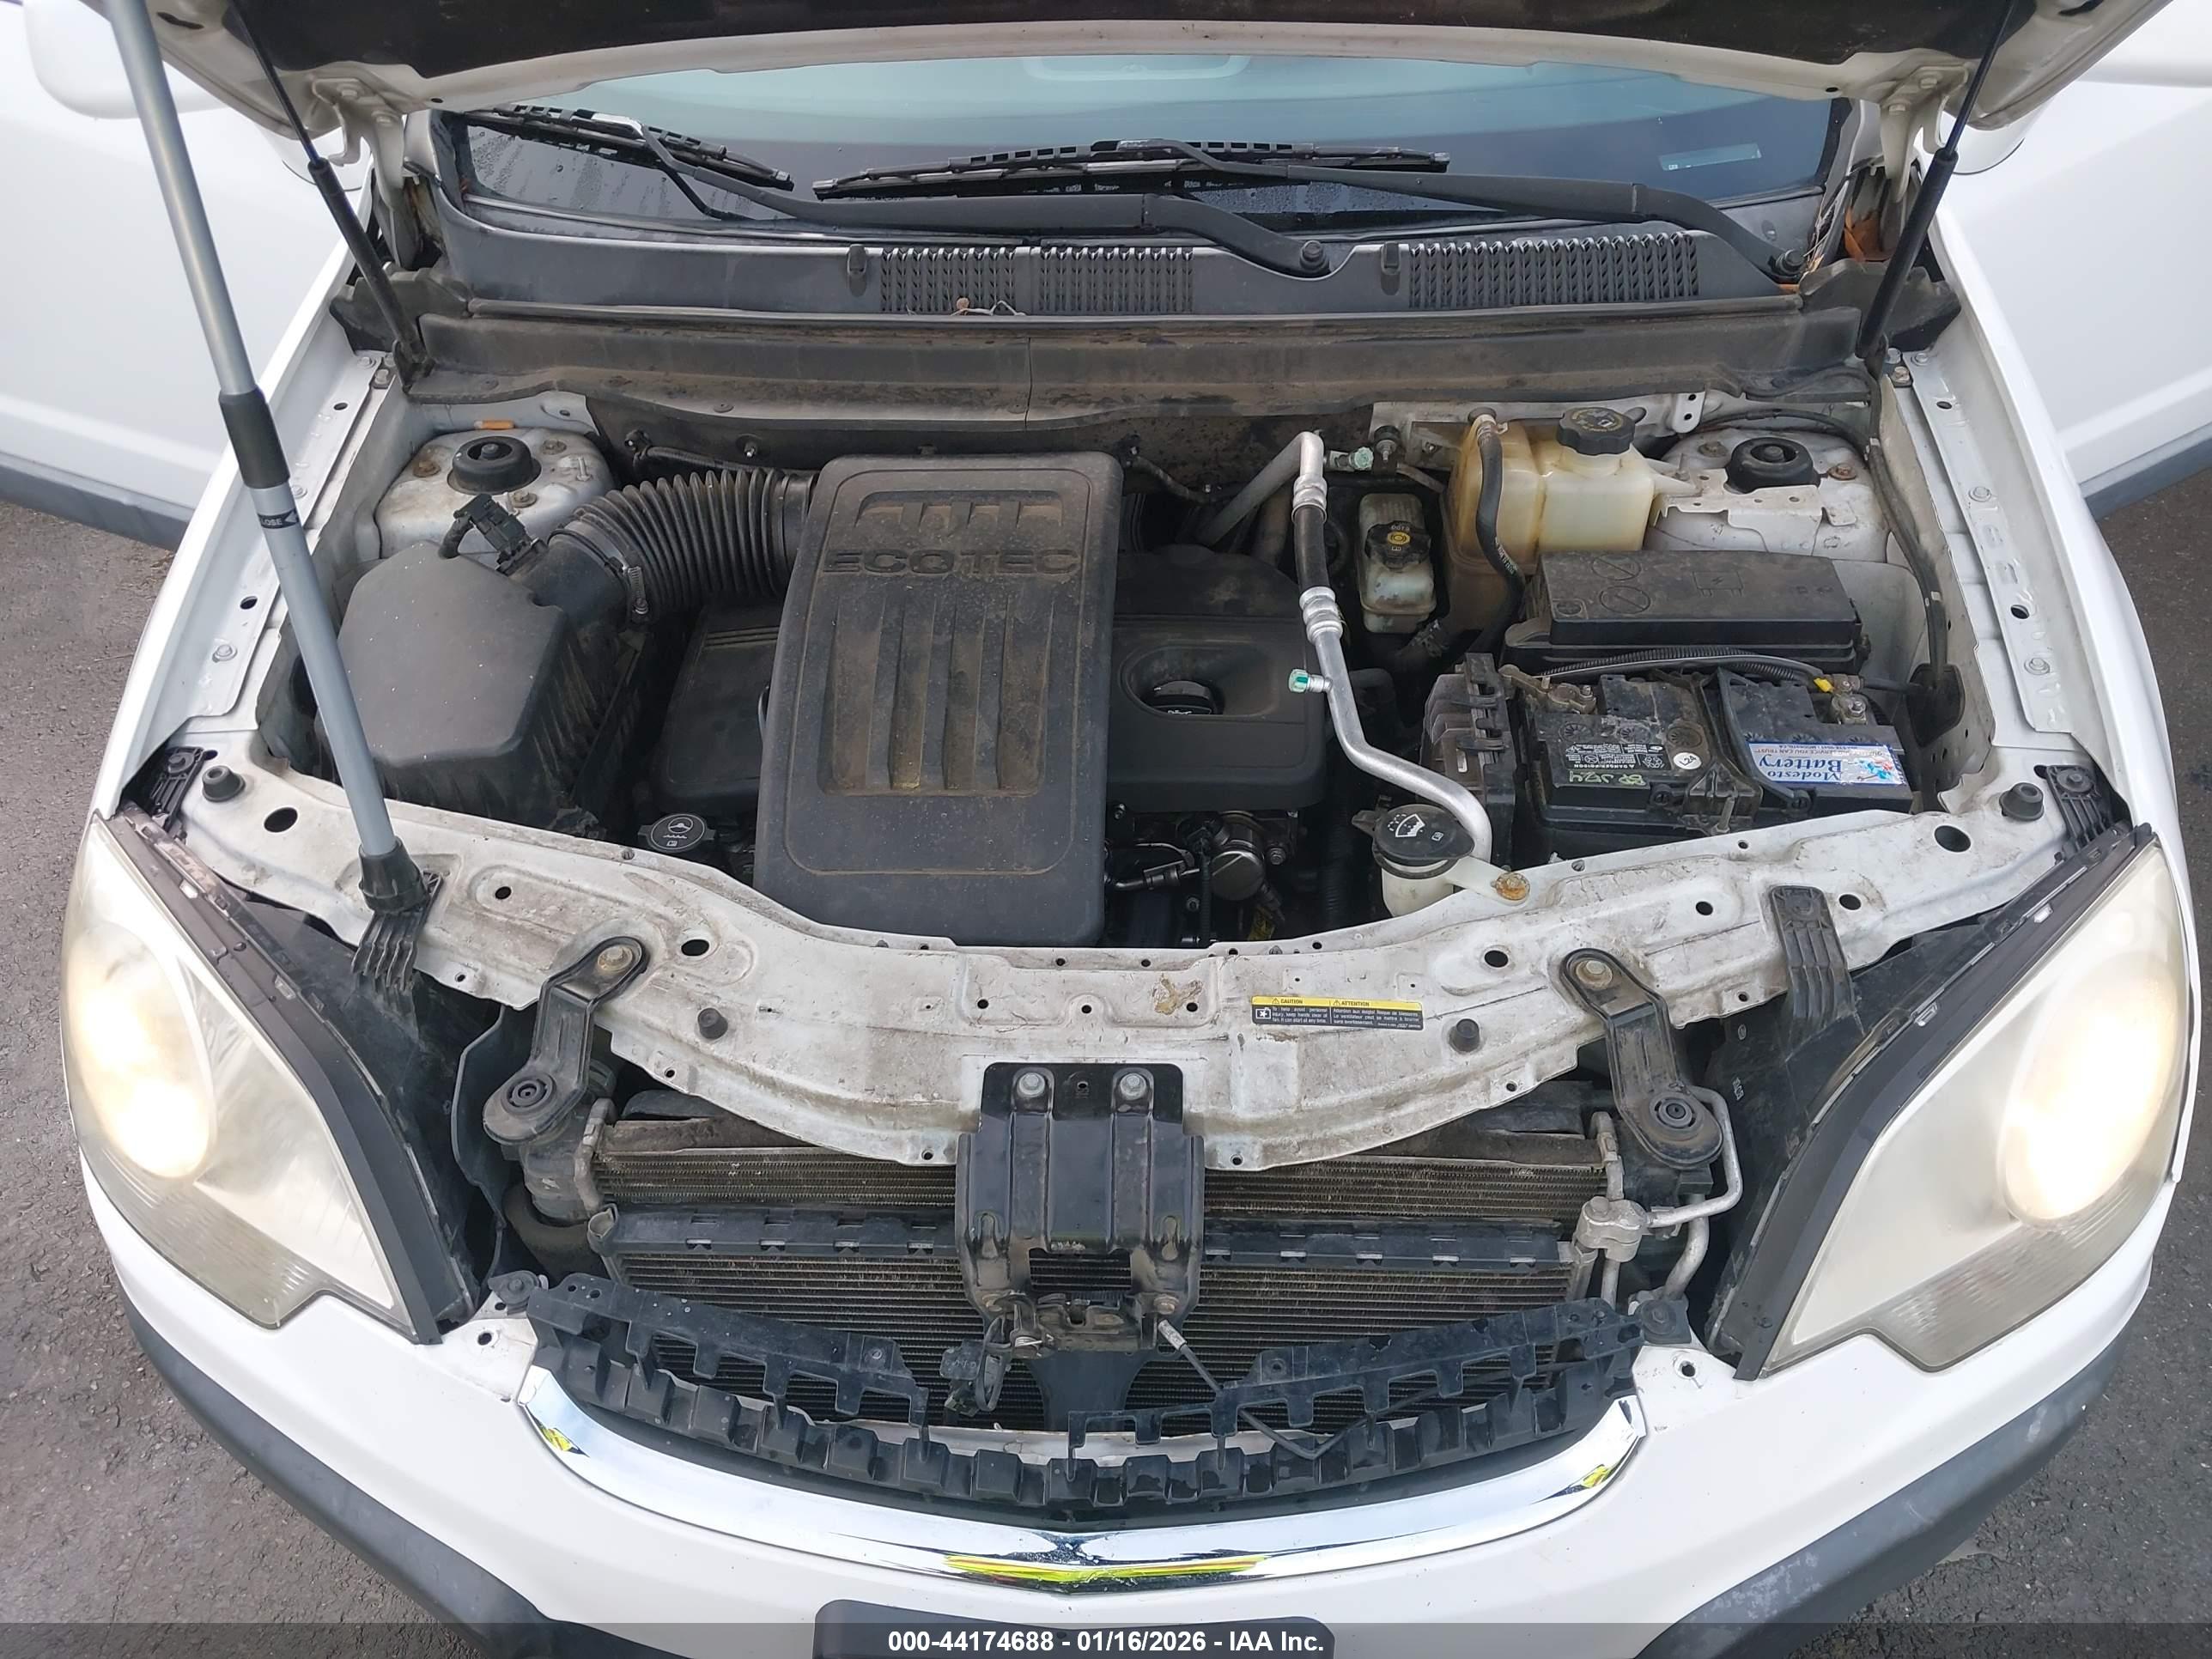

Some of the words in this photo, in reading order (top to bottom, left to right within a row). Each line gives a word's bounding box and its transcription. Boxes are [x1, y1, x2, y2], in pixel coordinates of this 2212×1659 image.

[822, 548, 1080, 575] ECOTEC
[1679, 755, 1697, 766] L24
[1759, 754, 1842, 773] Battery
[1767, 771, 1842, 781] Modesto
